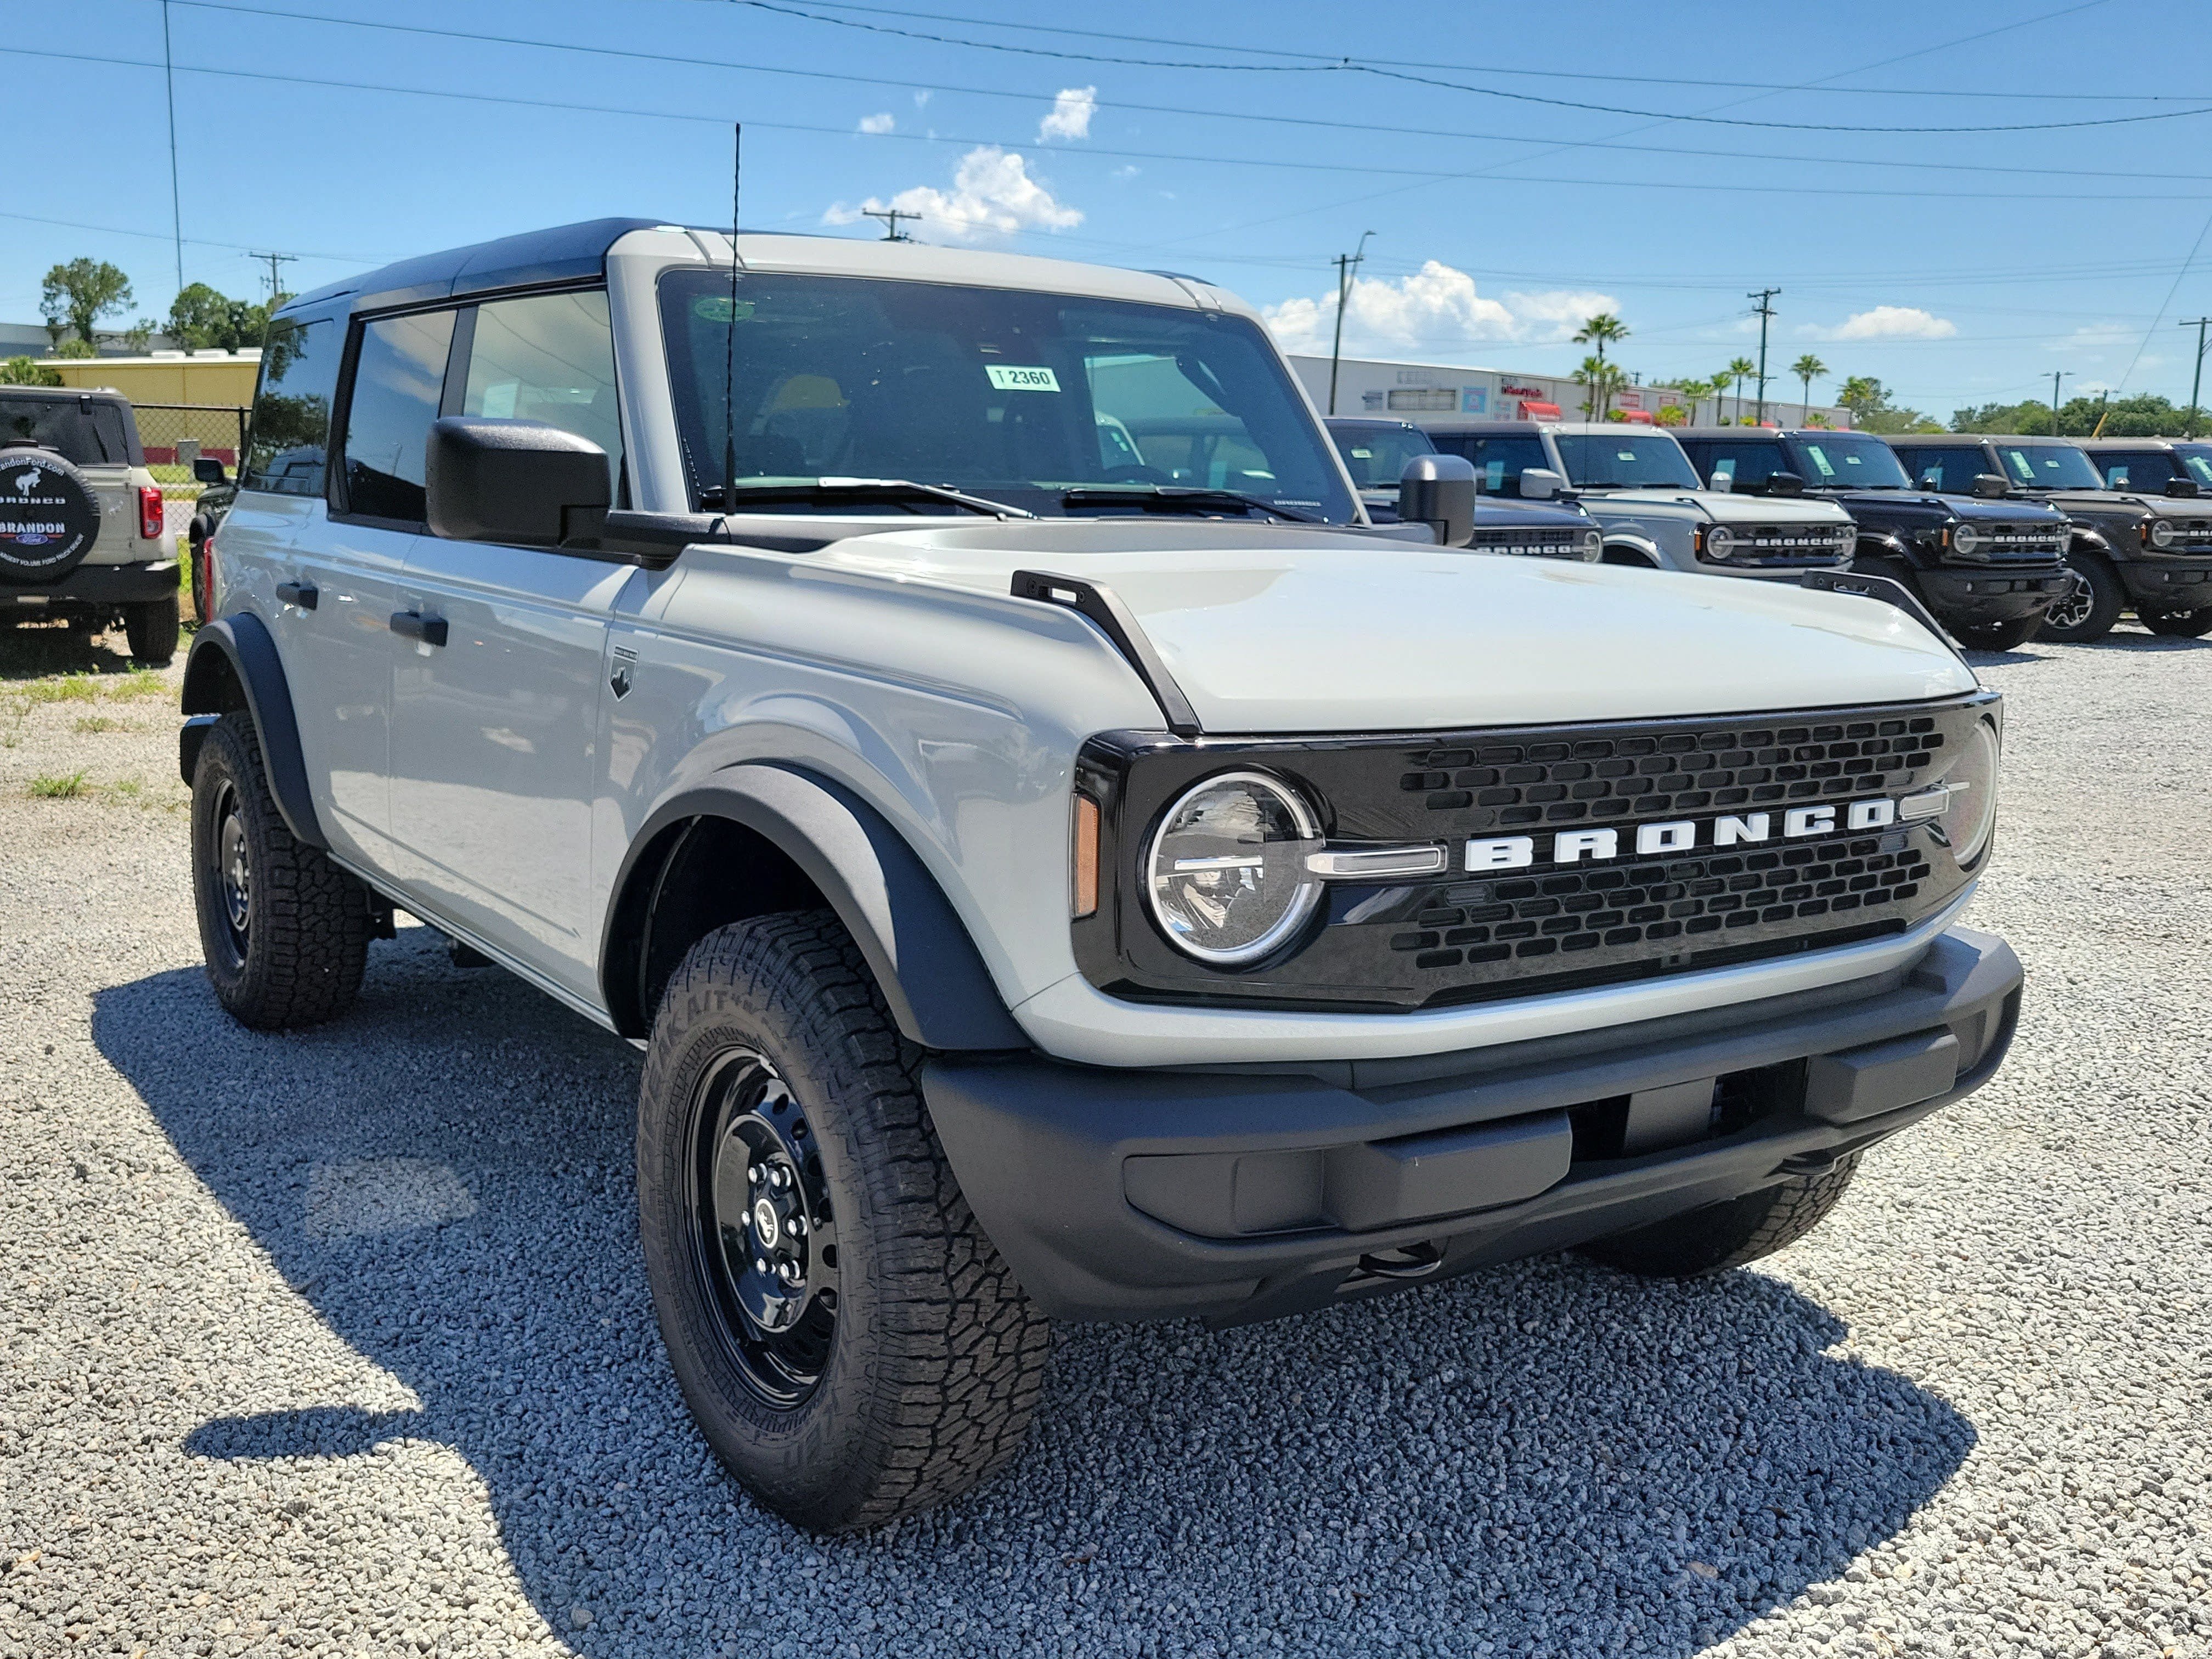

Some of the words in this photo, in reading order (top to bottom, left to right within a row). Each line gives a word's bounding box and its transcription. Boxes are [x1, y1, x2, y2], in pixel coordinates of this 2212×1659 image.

[996, 370, 1005, 383] T
[1008, 370, 1051, 385] 2360
[0, 456, 65, 476] andonFord.com
[0, 522, 65, 533] BRANDON
[1756, 538, 1833, 546] BRONCO
[1464, 799, 1895, 872] BRONCO
